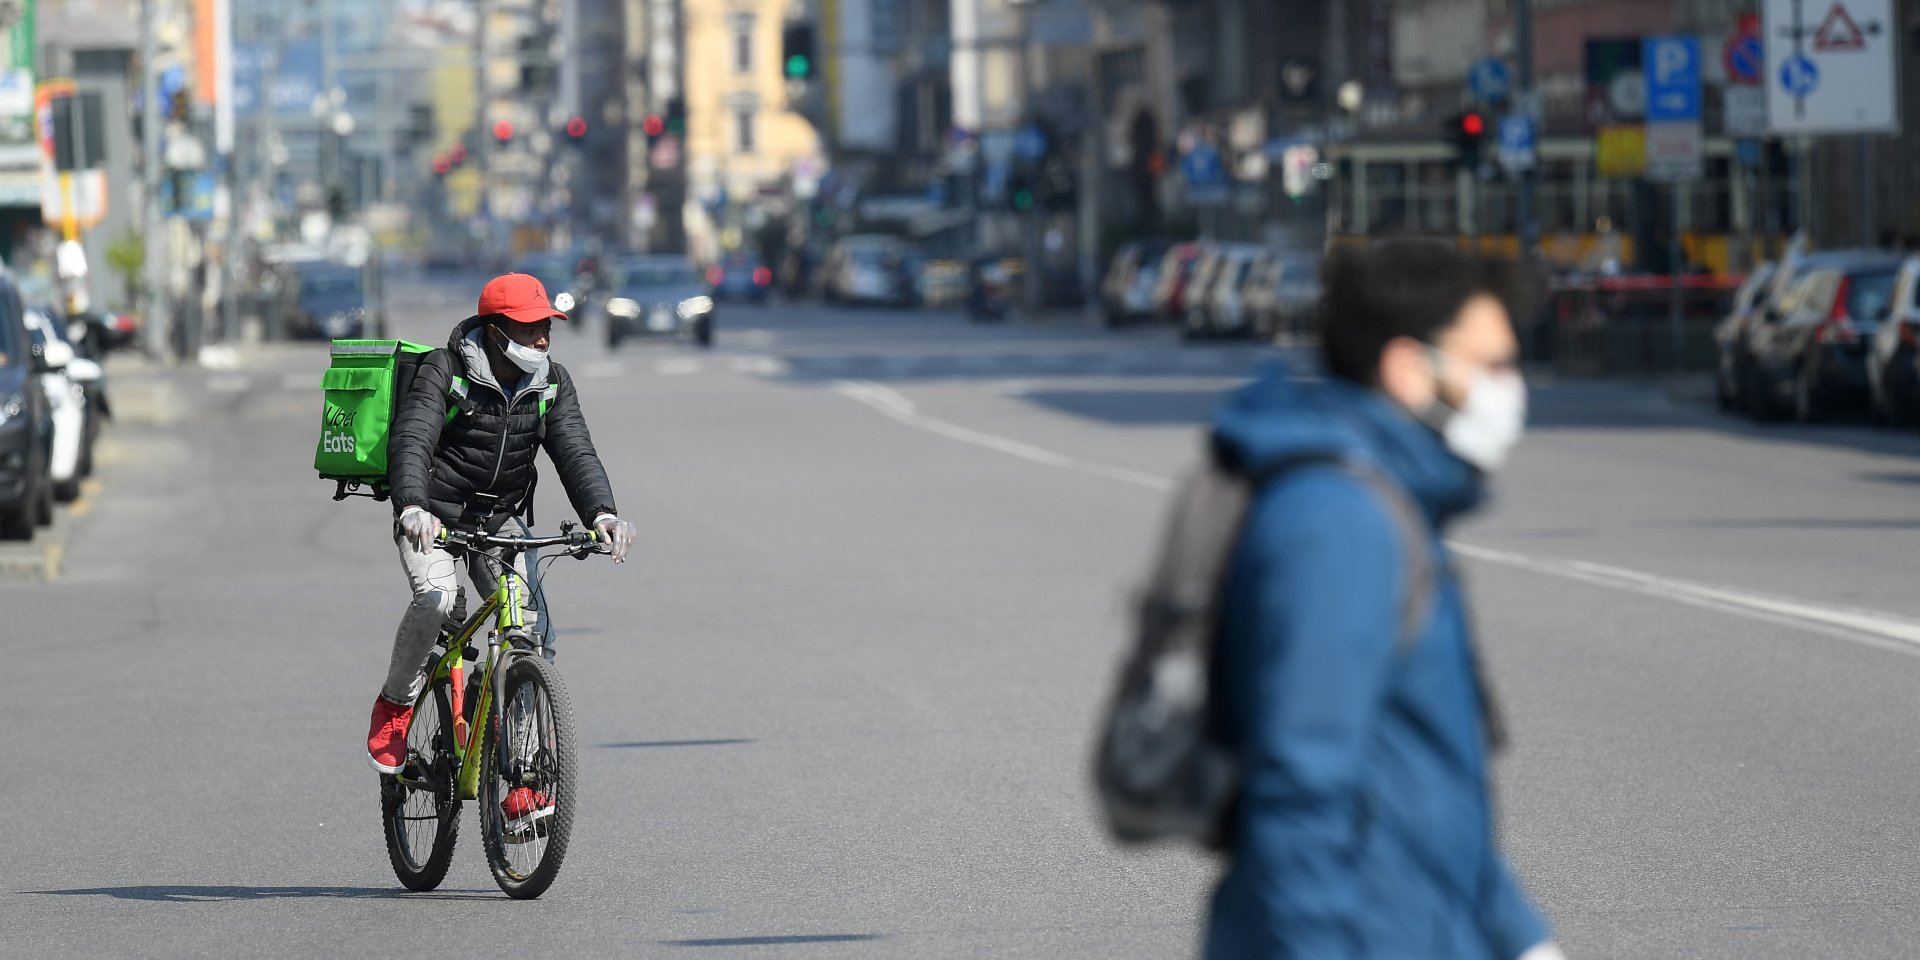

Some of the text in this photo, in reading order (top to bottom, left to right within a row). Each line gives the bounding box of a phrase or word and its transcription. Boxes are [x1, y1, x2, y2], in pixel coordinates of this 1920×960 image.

[1656, 40, 1690, 86] P
[325, 406, 357, 427] Uber
[323, 430, 355, 453] Eats
